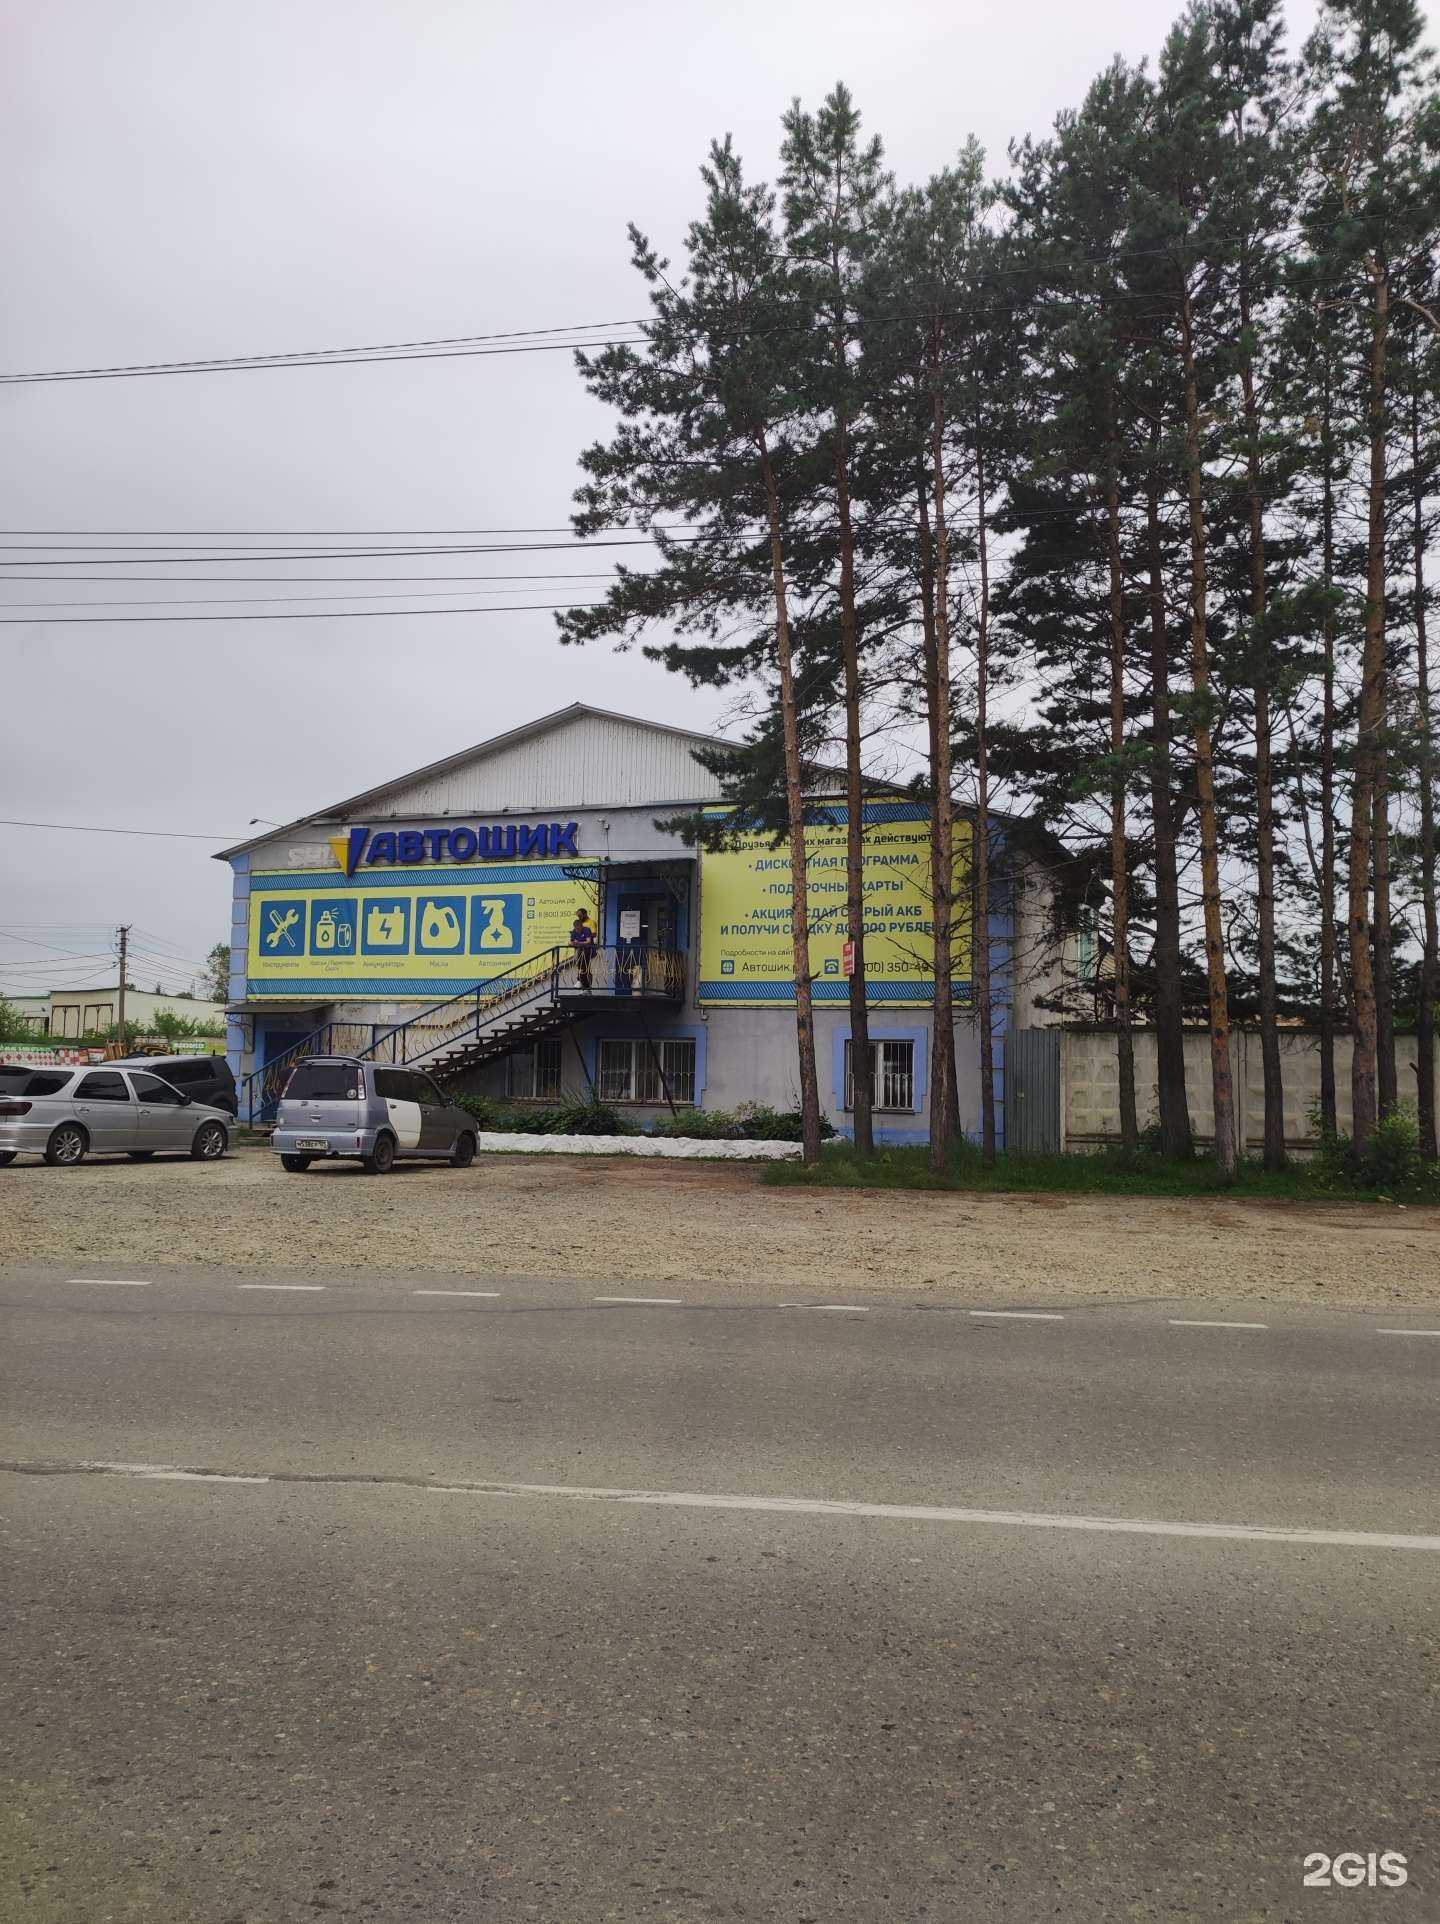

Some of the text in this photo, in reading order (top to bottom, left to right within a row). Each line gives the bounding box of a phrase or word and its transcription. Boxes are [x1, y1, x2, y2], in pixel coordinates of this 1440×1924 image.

[365, 822, 579, 864] АВТОШИК
[873, 830, 932, 845] действуют
[755, 857, 838, 871] ДИСКОТНАЯ
[769, 880, 849, 896] ПОДРОЧНЫ
[841, 904, 893, 918] СРЫЙ
[896, 905, 922, 917] АКБ
[720, 925, 729, 935] И
[731, 924, 780, 935] ПОЛУЧИ
[889, 920, 935, 933] РУБЛЕ
[720, 948, 767, 957] Подробности
